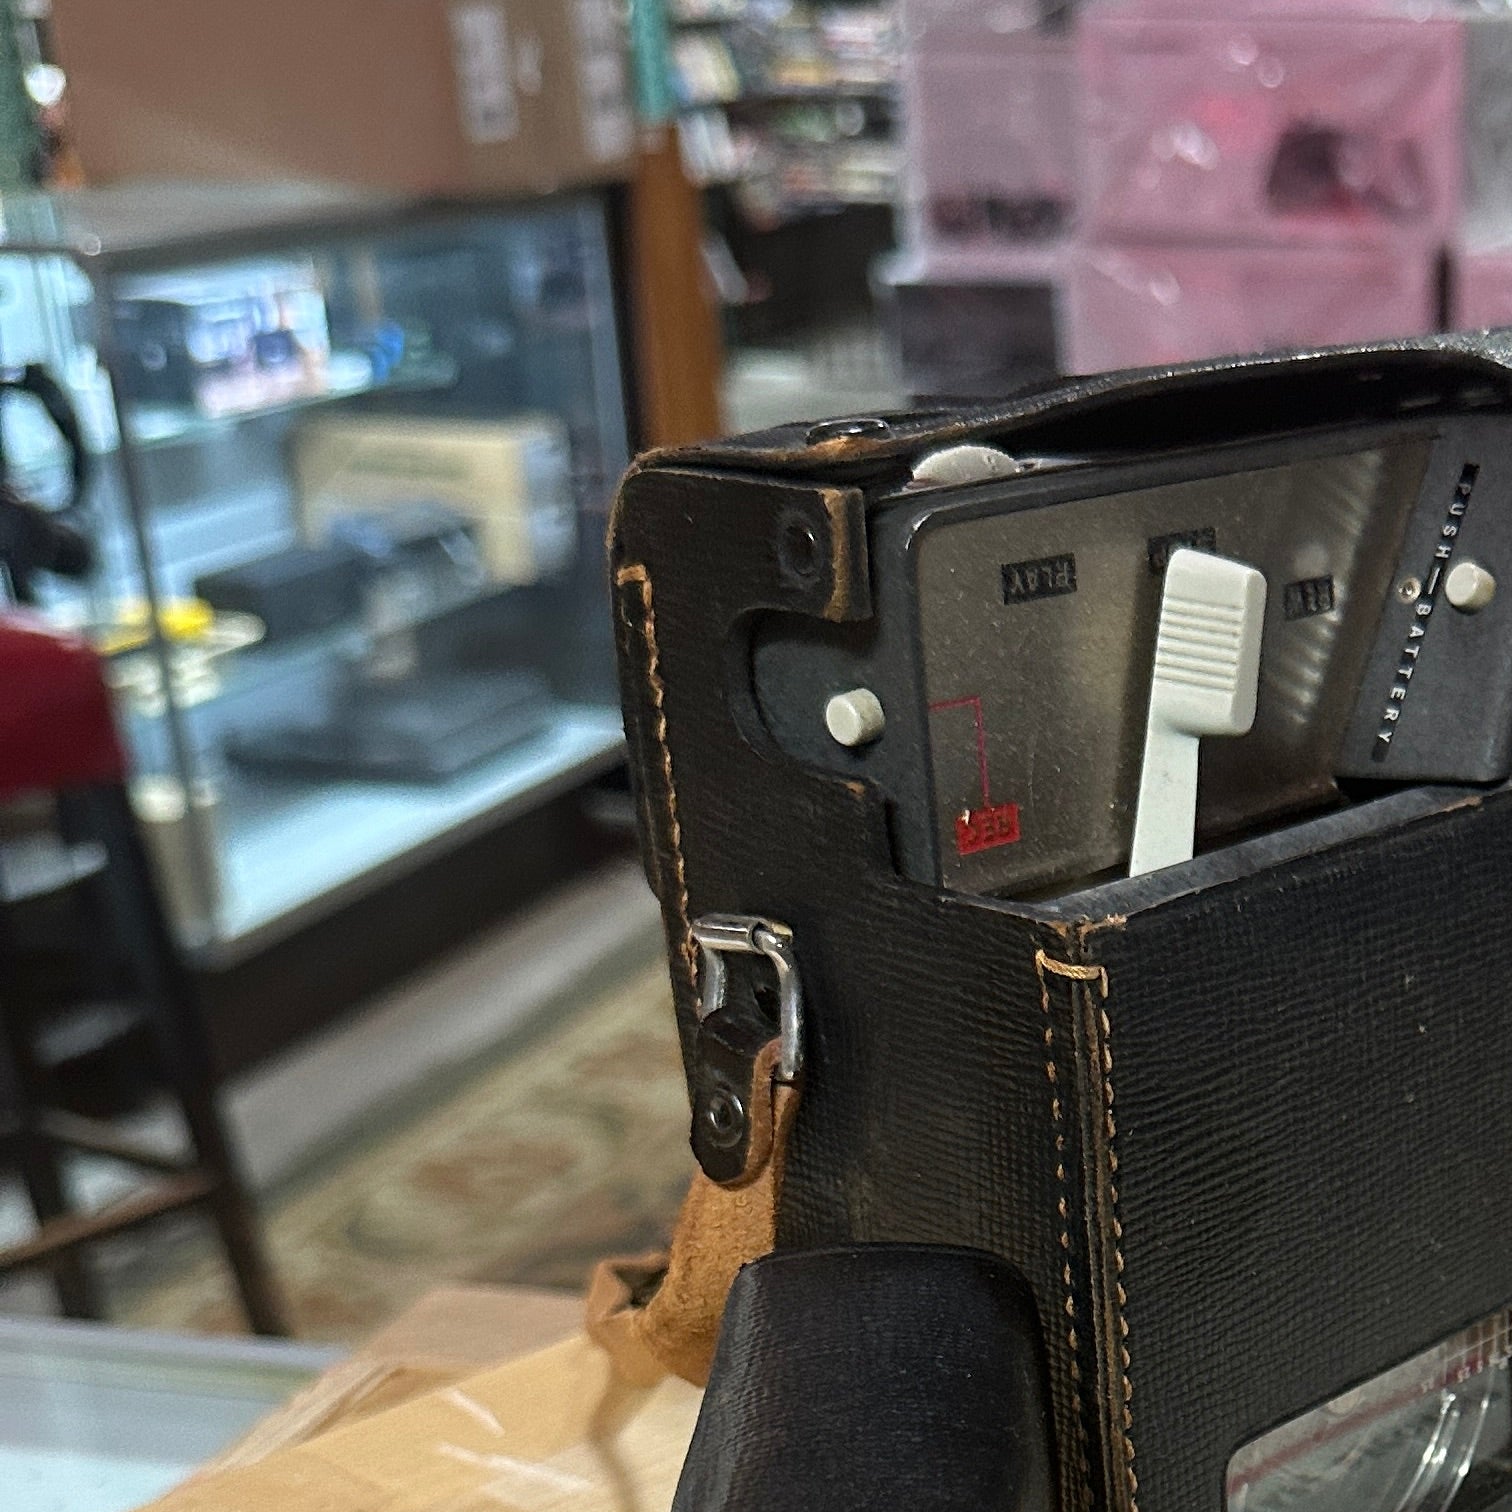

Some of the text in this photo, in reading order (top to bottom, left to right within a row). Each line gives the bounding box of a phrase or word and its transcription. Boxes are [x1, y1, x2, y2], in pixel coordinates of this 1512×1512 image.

[1434, 482, 1470, 559] PUSH
[1008, 560, 1073, 595] PLAY
[1376, 602, 1434, 744] BATTERY
